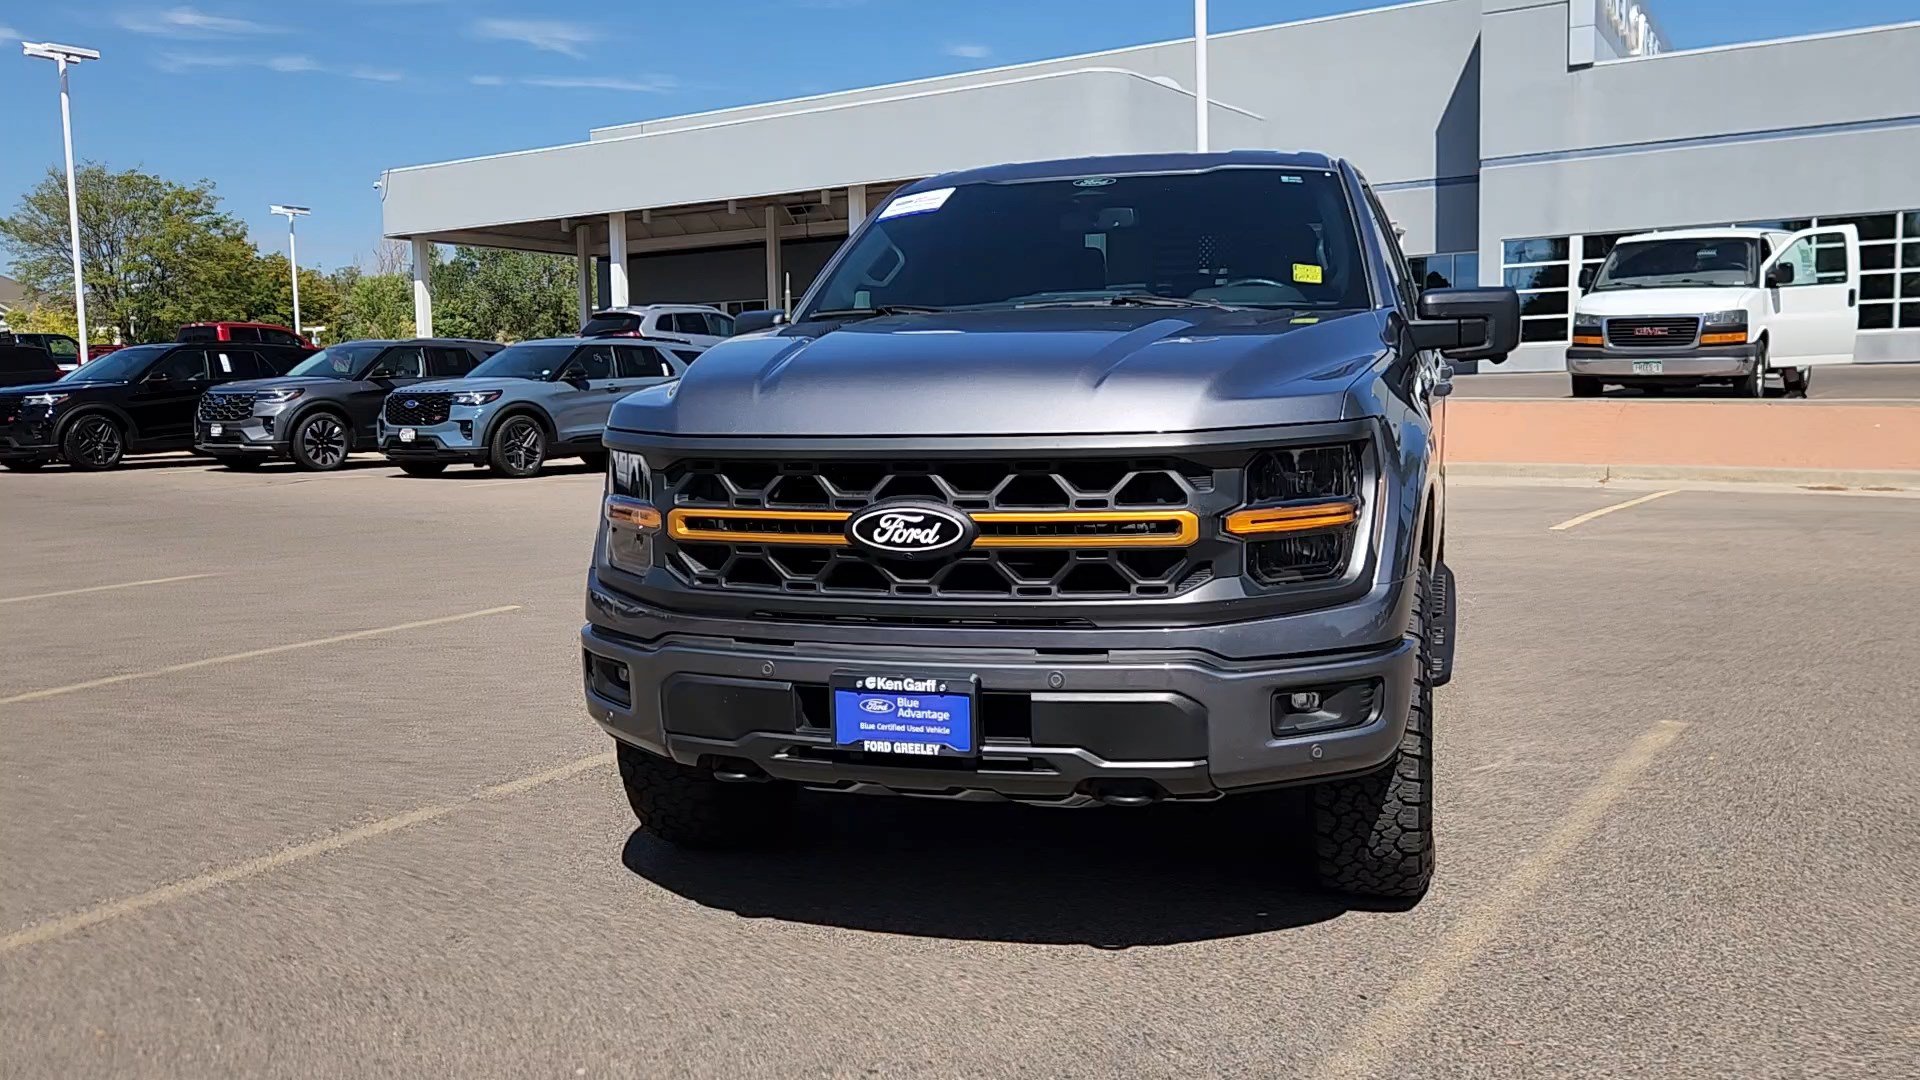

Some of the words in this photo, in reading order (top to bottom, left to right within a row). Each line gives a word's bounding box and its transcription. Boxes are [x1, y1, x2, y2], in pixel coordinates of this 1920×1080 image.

[1634, 327, 1668, 335] GMC
[873, 513, 941, 544] Ford
[877, 677, 902, 690] Ken
[903, 678, 937, 692] Garff
[866, 700, 888, 711] Ford
[897, 697, 919, 707] Blue
[897, 708, 950, 721] Advantage
[860, 722, 875, 730] Blue
[877, 723, 905, 732] Certified
[907, 725, 924, 733] Used
[925, 725, 950, 734] Vehicle
[864, 740, 891, 753] FORD
[893, 742, 940, 755] GREELEY
